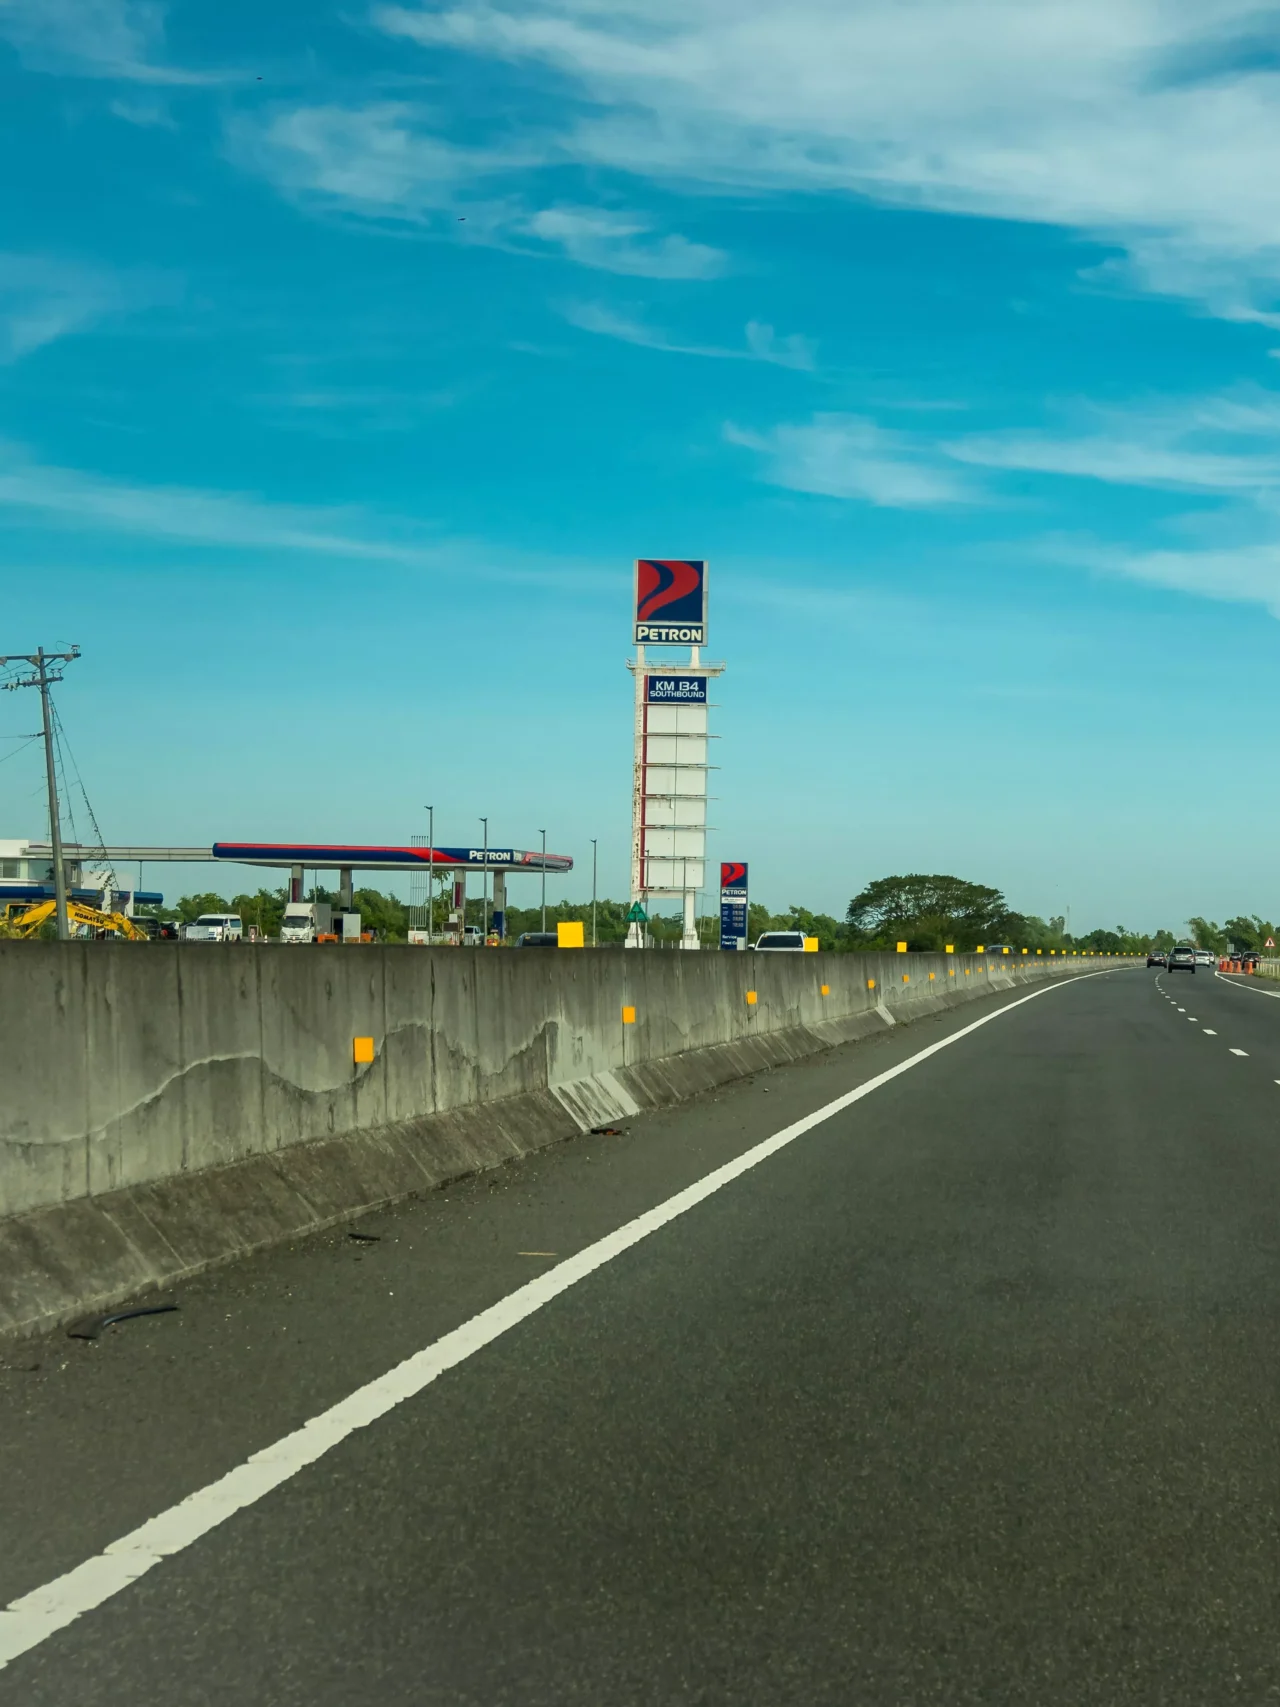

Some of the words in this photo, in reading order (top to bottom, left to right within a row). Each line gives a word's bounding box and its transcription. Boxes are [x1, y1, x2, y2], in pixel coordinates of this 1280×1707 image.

[637, 626, 702, 641] PETRON
[655, 681, 675, 691] KM
[679, 681, 699, 691] 134
[650, 690, 705, 698] SOUTHBOUND
[74, 912, 104, 924] KOMATSU
